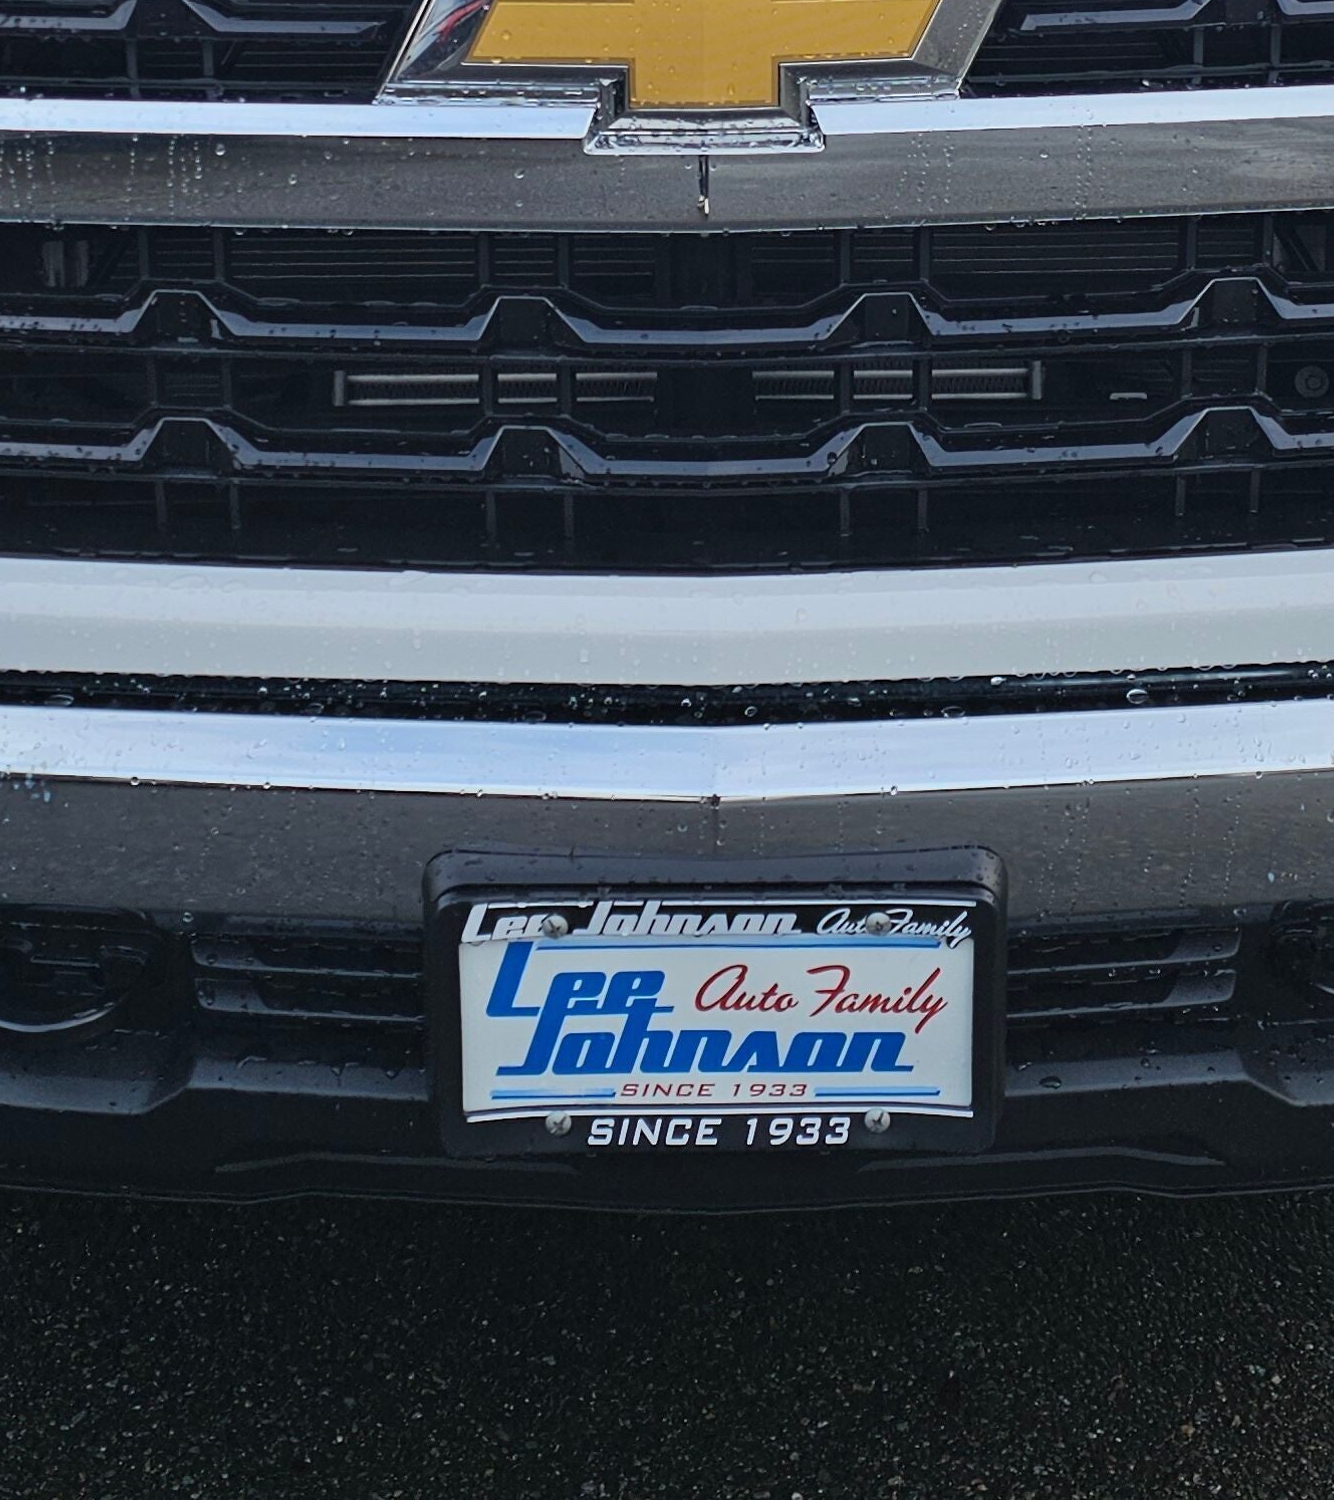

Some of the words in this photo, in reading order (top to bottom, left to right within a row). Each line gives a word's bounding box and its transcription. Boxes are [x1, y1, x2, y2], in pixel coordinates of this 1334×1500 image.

[572, 900, 802, 936] Johnson
[817, 908, 871, 936] Aut
[884, 908, 971, 949] Family
[485, 941, 674, 1017] Lee
[694, 964, 797, 1014] Auto
[806, 964, 948, 1034] Family
[495, 1002, 914, 1077] Johnson
[620, 1083, 716, 1097] SINCE
[731, 1083, 808, 1097] 1933
[587, 1117, 722, 1146] SINCE
[745, 1116, 851, 1145] 1933
